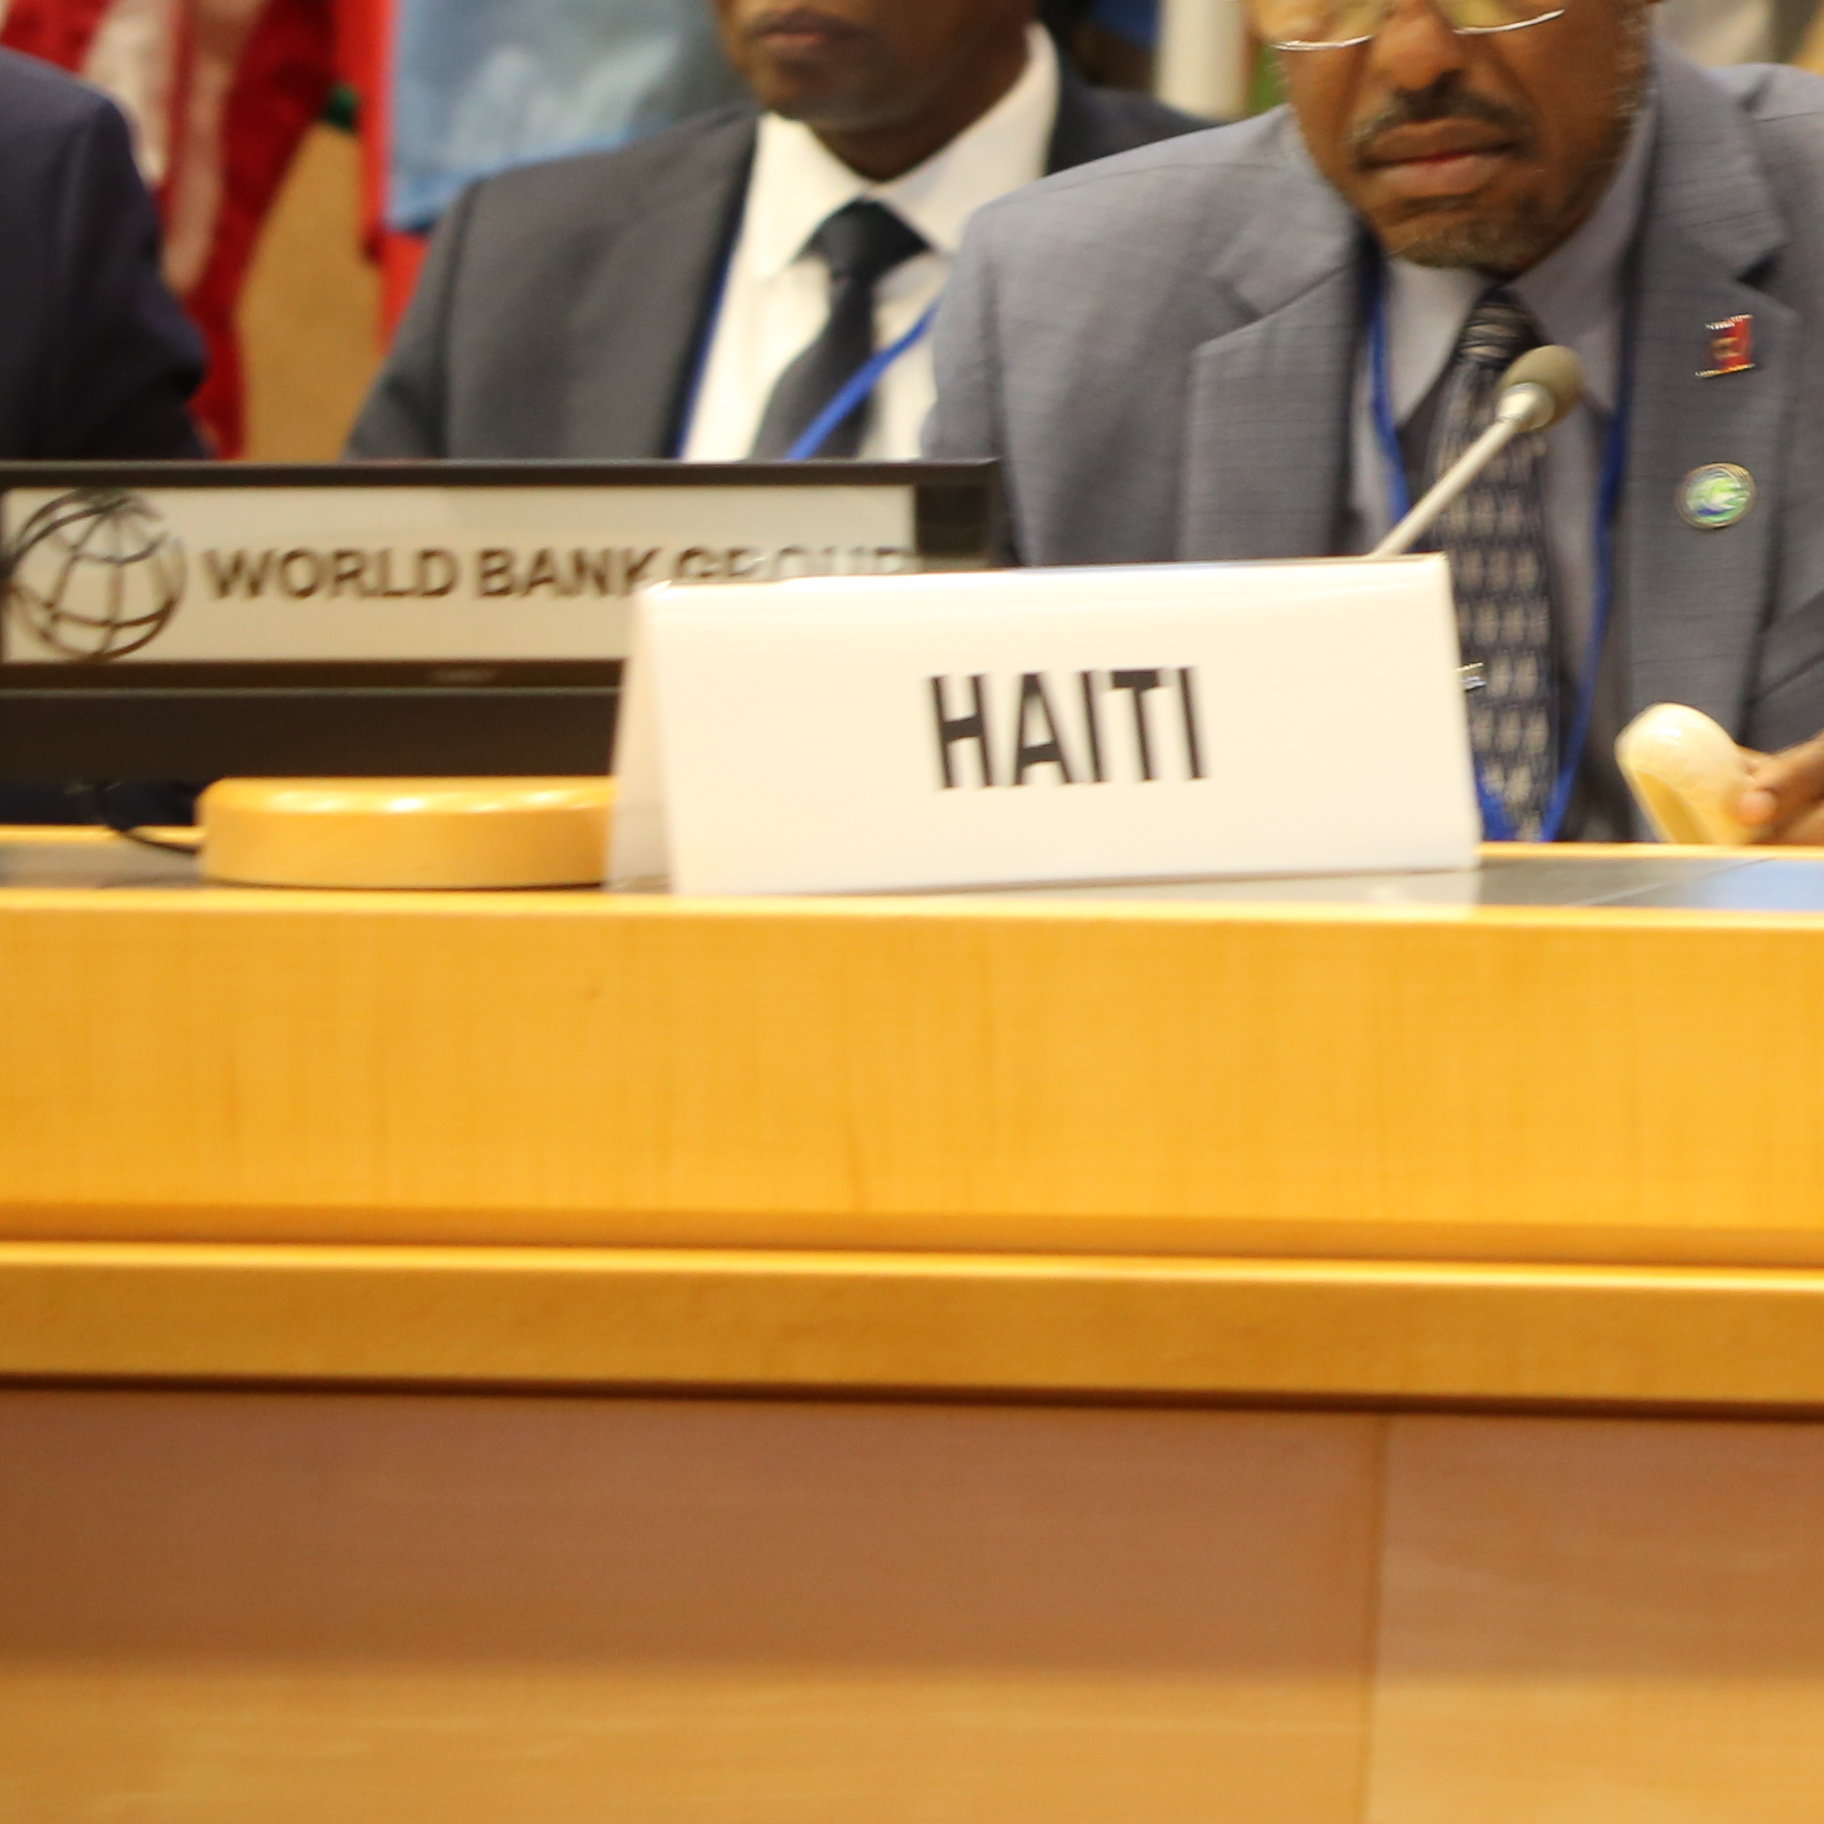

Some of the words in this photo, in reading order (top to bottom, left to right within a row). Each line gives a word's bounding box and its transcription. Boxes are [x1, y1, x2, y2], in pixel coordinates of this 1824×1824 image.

[203, 547, 458, 600] WORLD
[476, 547, 660, 599] BANK
[927, 664, 1209, 791] HAITI
